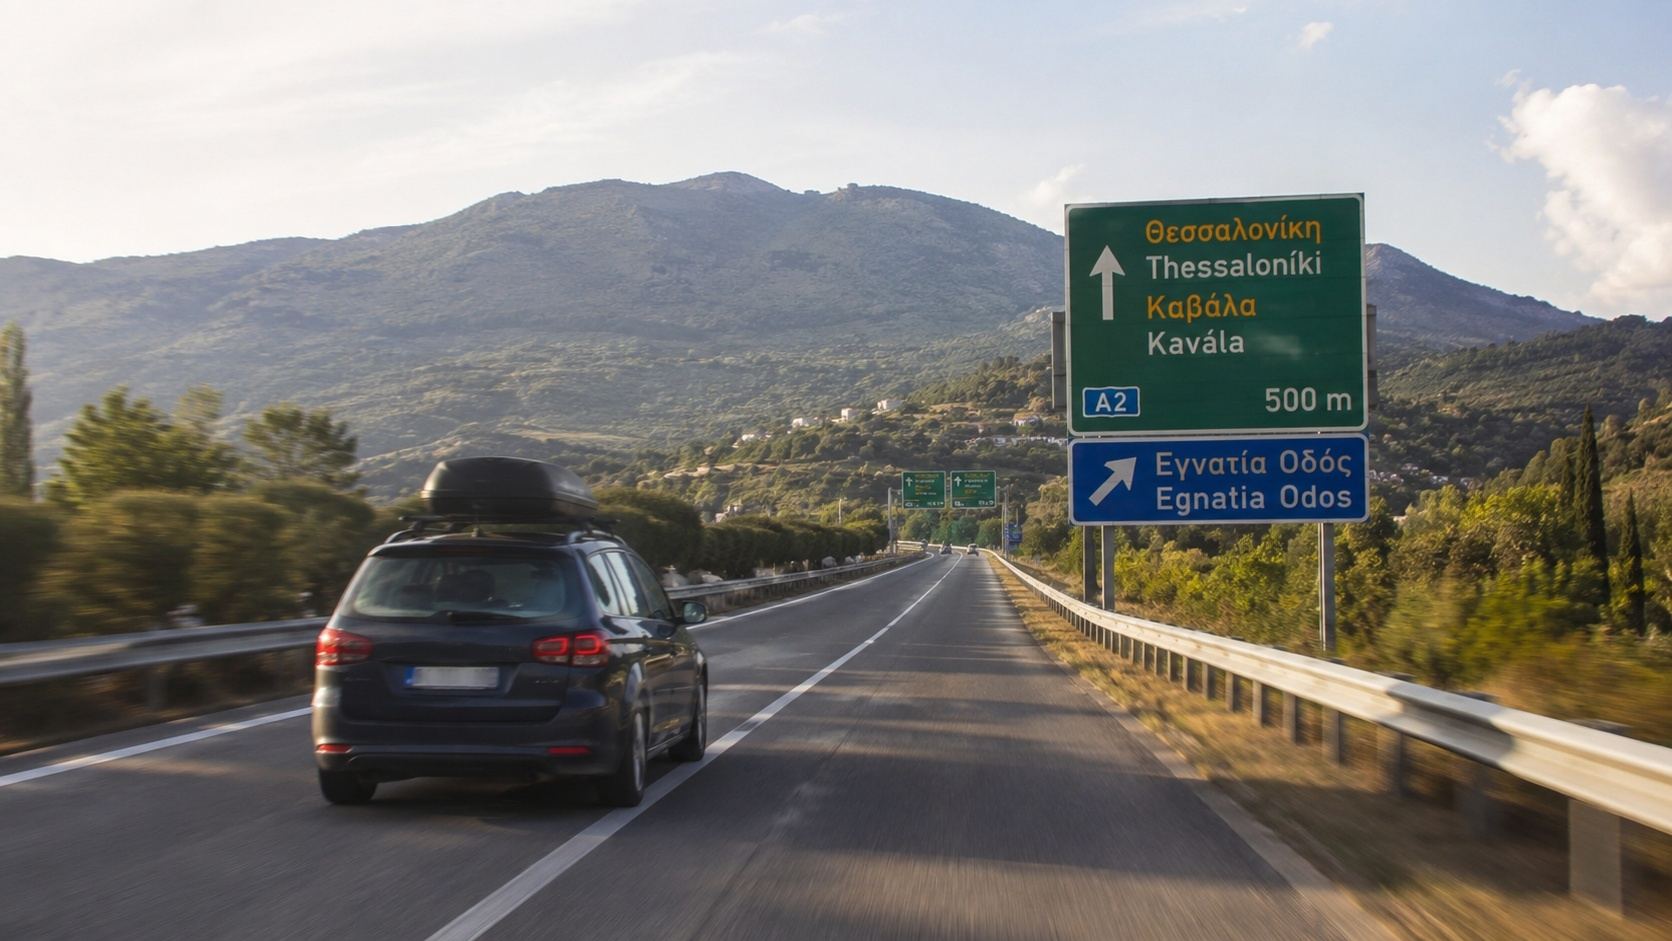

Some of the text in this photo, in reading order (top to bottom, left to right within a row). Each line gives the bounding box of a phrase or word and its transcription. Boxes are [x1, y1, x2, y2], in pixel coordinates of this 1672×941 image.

[1146, 215, 1321, 244] Θεσσαλονίκη
[1146, 251, 1321, 279] Thessaloníki
[1147, 293, 1256, 323] Καβάλα
[1148, 330, 1244, 355] Kavála
[1095, 393, 1127, 412] A2
[1265, 387, 1352, 412] 500 m
[1156, 449, 1351, 480] Εγνατία Οδός
[1157, 484, 1351, 515] Egnatia Odos
